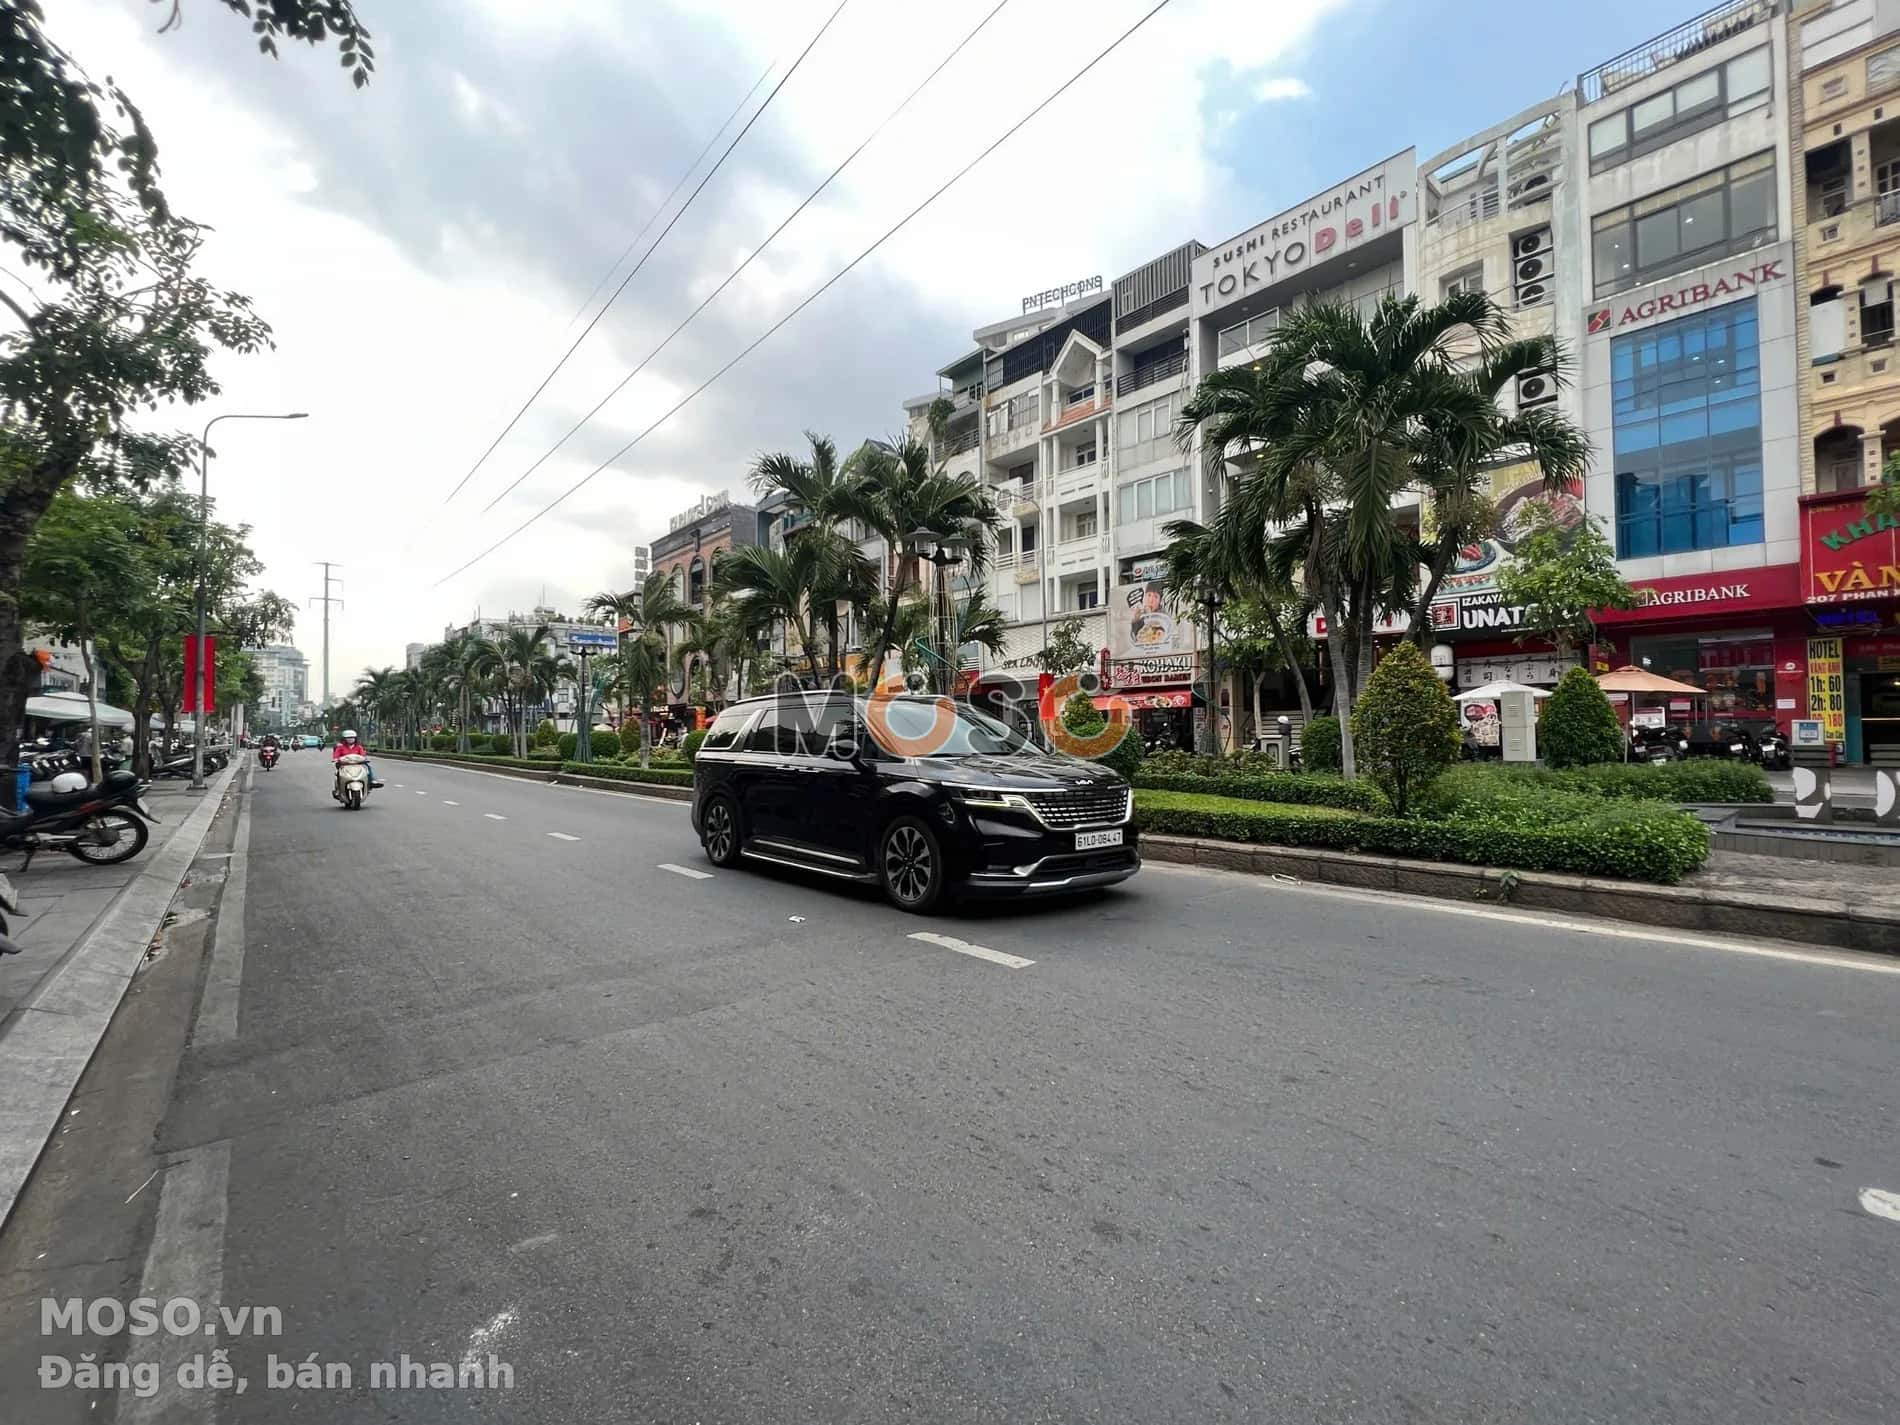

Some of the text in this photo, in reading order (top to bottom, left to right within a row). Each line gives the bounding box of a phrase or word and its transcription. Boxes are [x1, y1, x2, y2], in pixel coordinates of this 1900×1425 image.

[1213, 175, 1385, 268] SUSHI RESTAURANT
[1199, 241, 1305, 304] TOKYO
[1618, 259, 1786, 326] AGRIBANK
[1648, 584, 1751, 606] AGRIBANK
[1809, 639, 1840, 659] HOTEL
[1140, 656, 1192, 673] KOHAKU
[1810, 675, 1841, 693] 1h: 60
[1811, 694, 1826, 712] 2h:
[1829, 693, 1842, 711] 80
